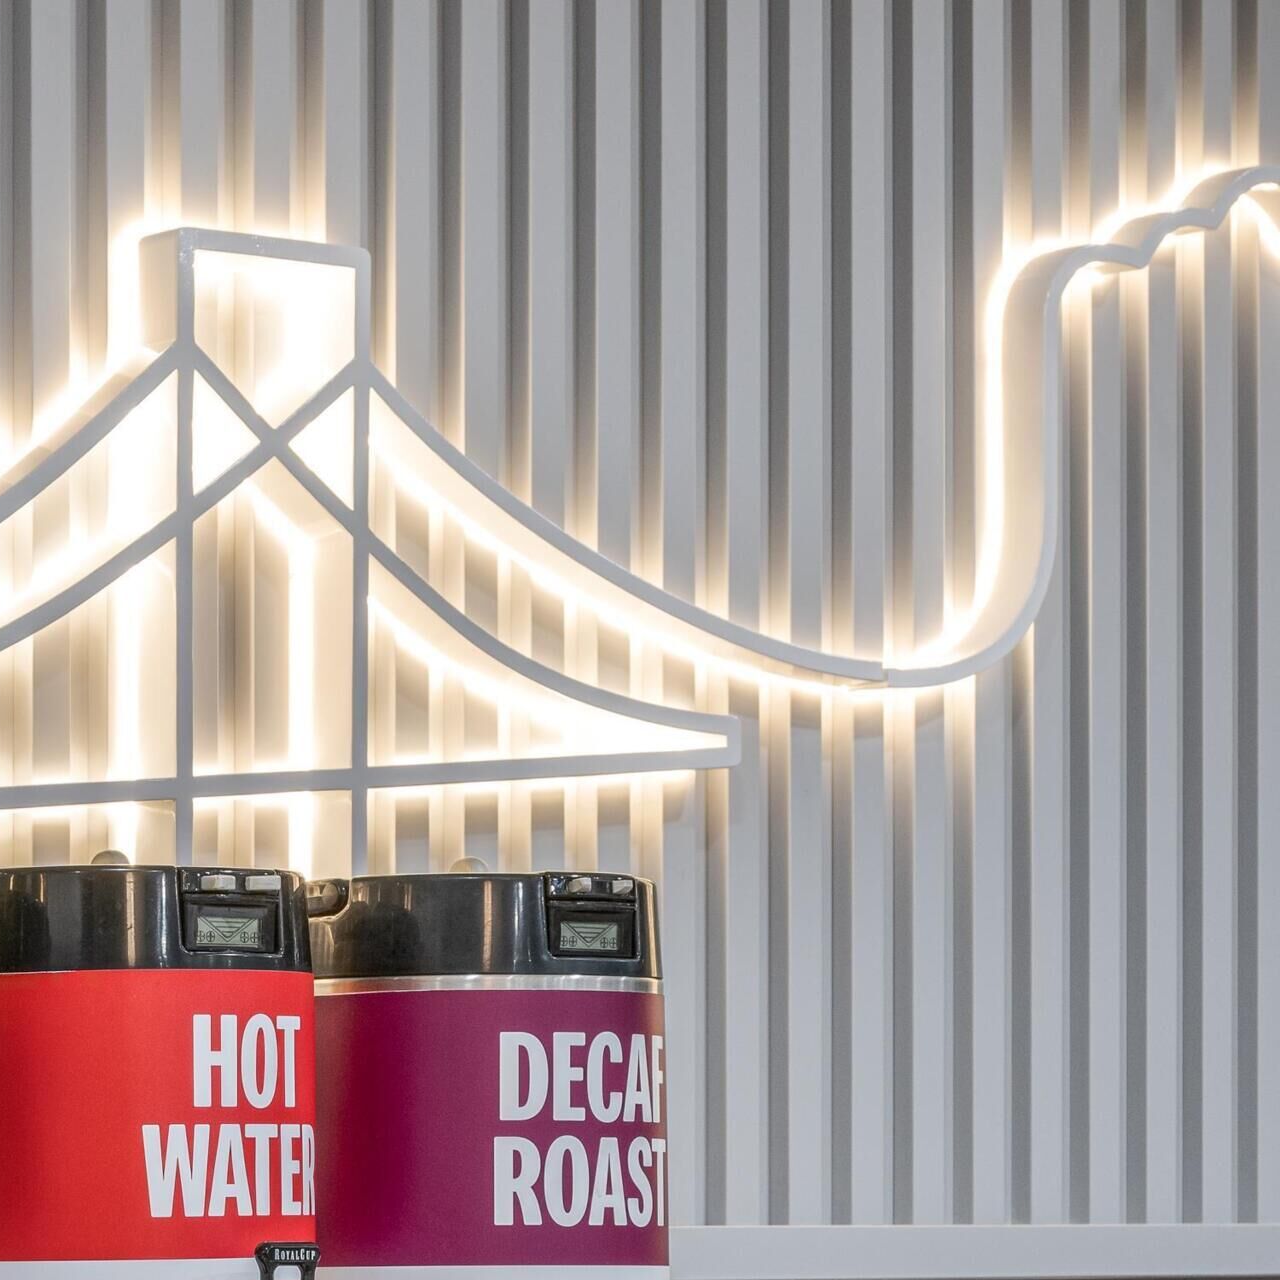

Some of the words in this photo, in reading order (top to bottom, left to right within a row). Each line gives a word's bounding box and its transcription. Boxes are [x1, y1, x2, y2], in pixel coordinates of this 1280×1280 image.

[192, 1013, 301, 1109] HOT
[499, 1031, 664, 1124] DECAF
[142, 1123, 316, 1218] WATER
[493, 1134, 666, 1228] ROAST
